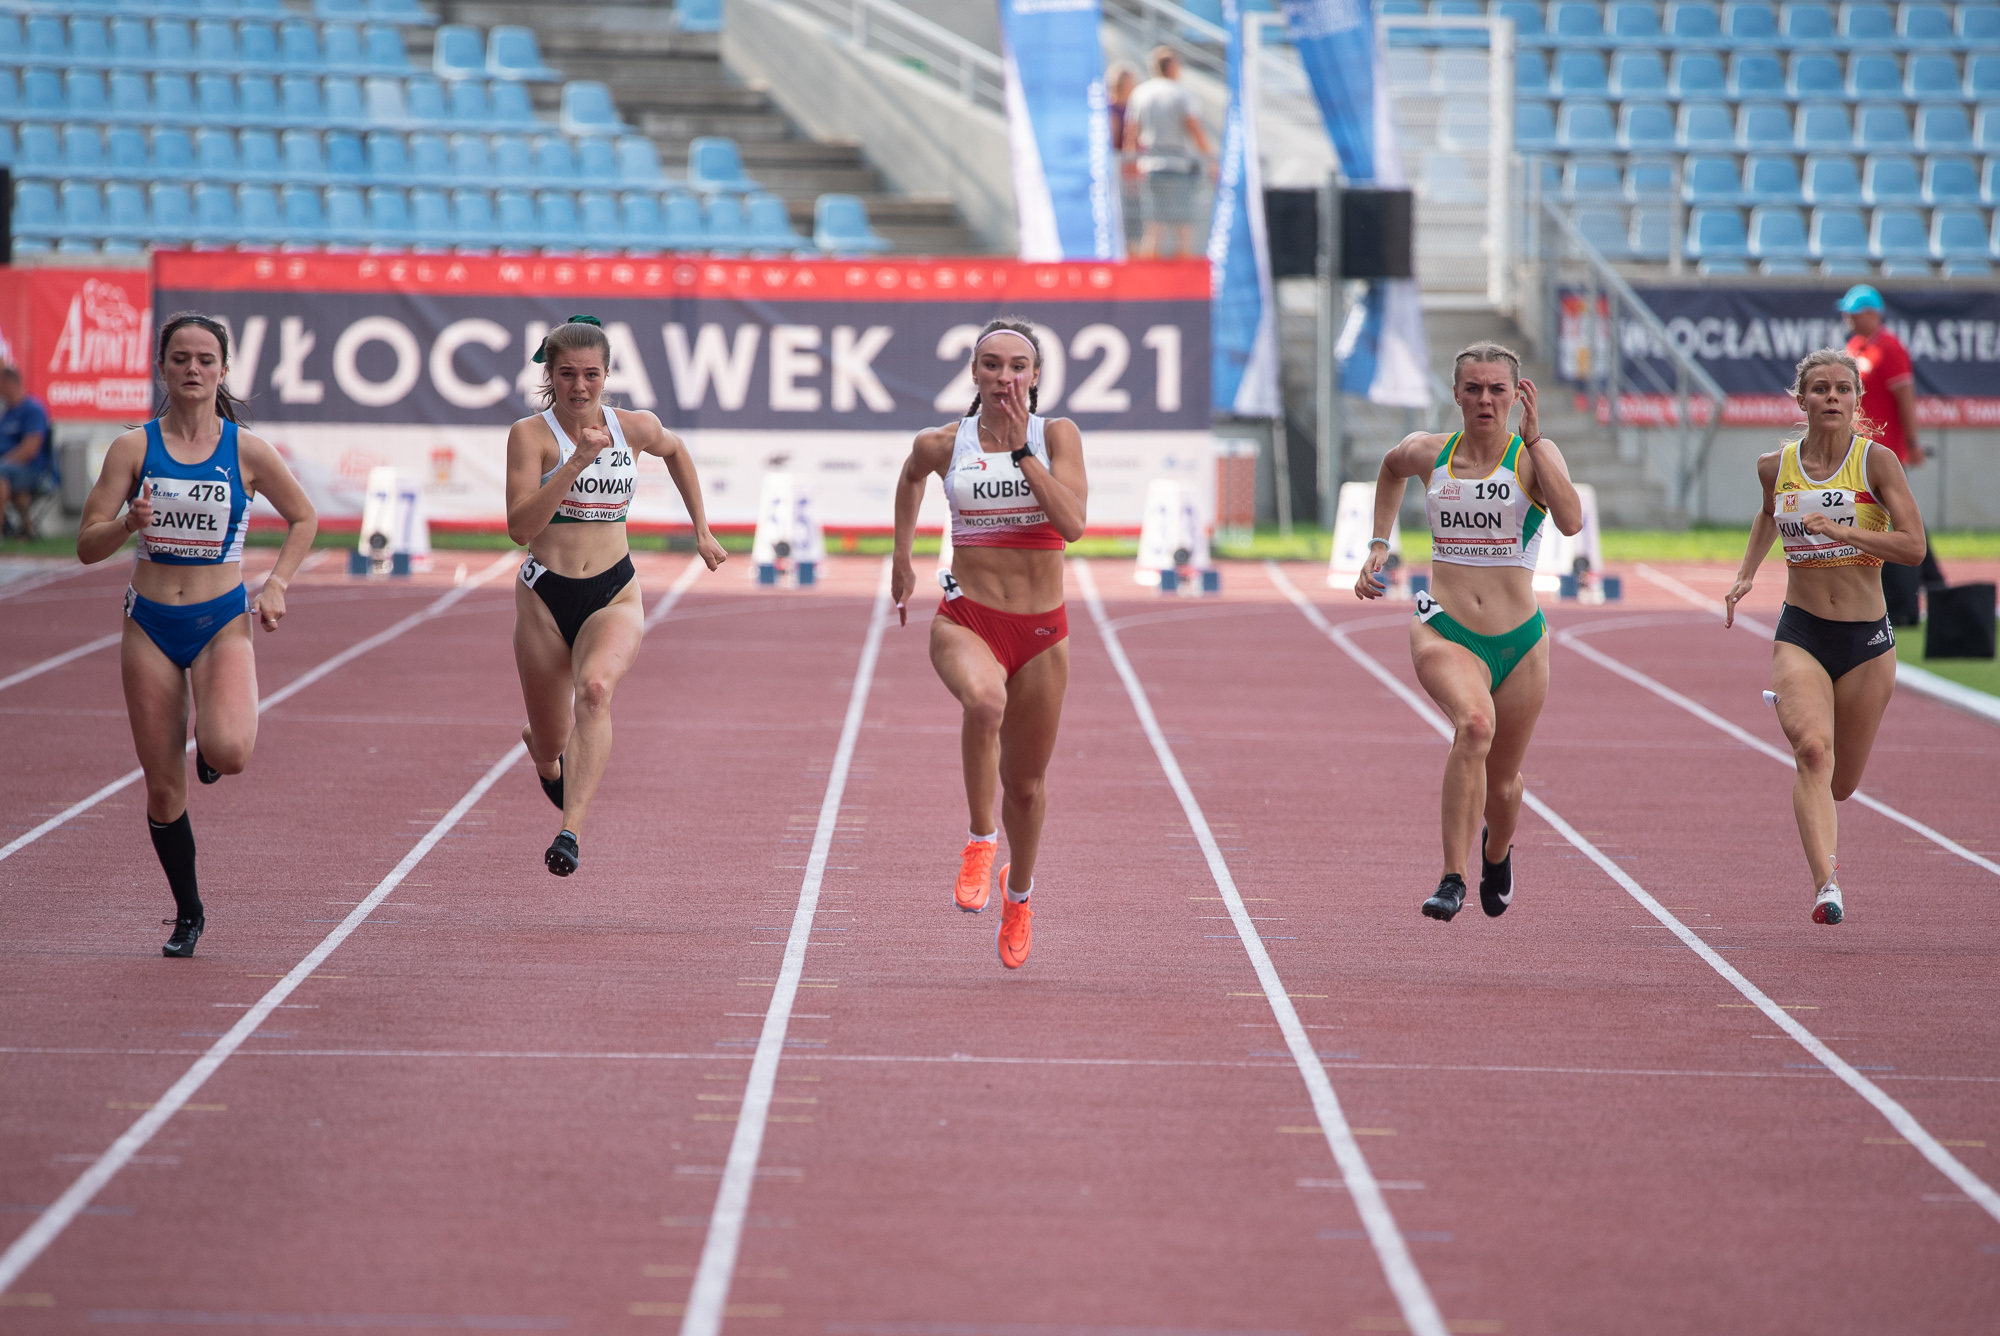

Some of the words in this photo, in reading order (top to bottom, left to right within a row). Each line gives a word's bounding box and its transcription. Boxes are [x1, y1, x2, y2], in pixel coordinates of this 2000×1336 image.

[610, 451, 631, 467] 206
[188, 485, 225, 502] 478
[571, 478, 633, 494] NOWAK
[974, 480, 1030, 499] KUBIS
[1475, 483, 1510, 500] 190
[1822, 491, 1844, 507] 32
[151, 511, 218, 531] GAWEŁ
[566, 508, 616, 519] WŁOCŁAWEK
[964, 516, 1022, 526] WŁOCŁAWEK
[1025, 514, 1045, 524] 2021
[1441, 511, 1502, 529] BALON
[1491, 547, 1512, 555] 2021
[523, 559, 541, 581] 5
[944, 575, 958, 593] 4
